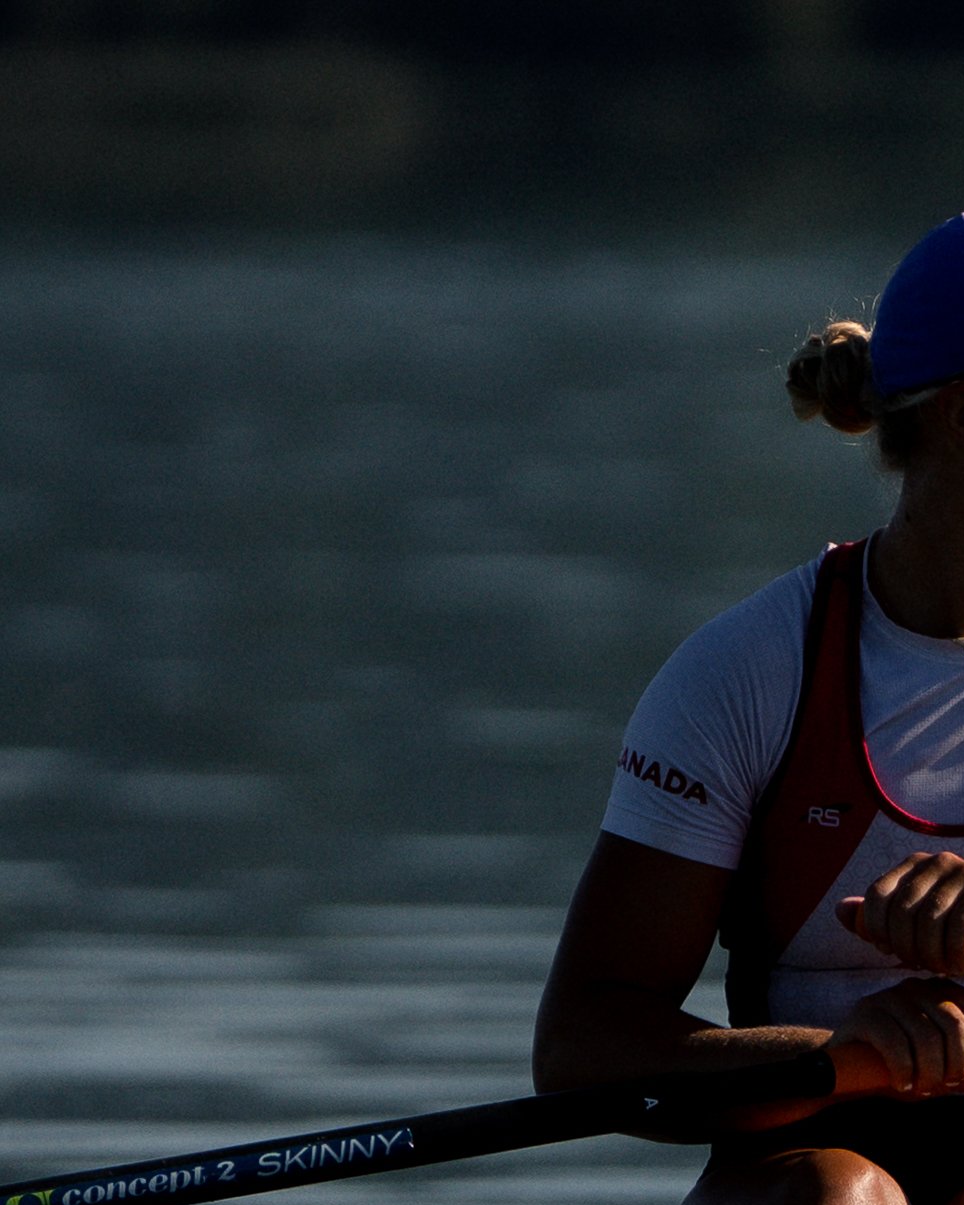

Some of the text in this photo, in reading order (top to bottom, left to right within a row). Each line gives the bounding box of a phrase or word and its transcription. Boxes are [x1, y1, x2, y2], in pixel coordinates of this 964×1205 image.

[808, 806, 840, 827] RS
[217, 1161, 236, 1181] 2
[257, 1129, 402, 1178] SKINNY
